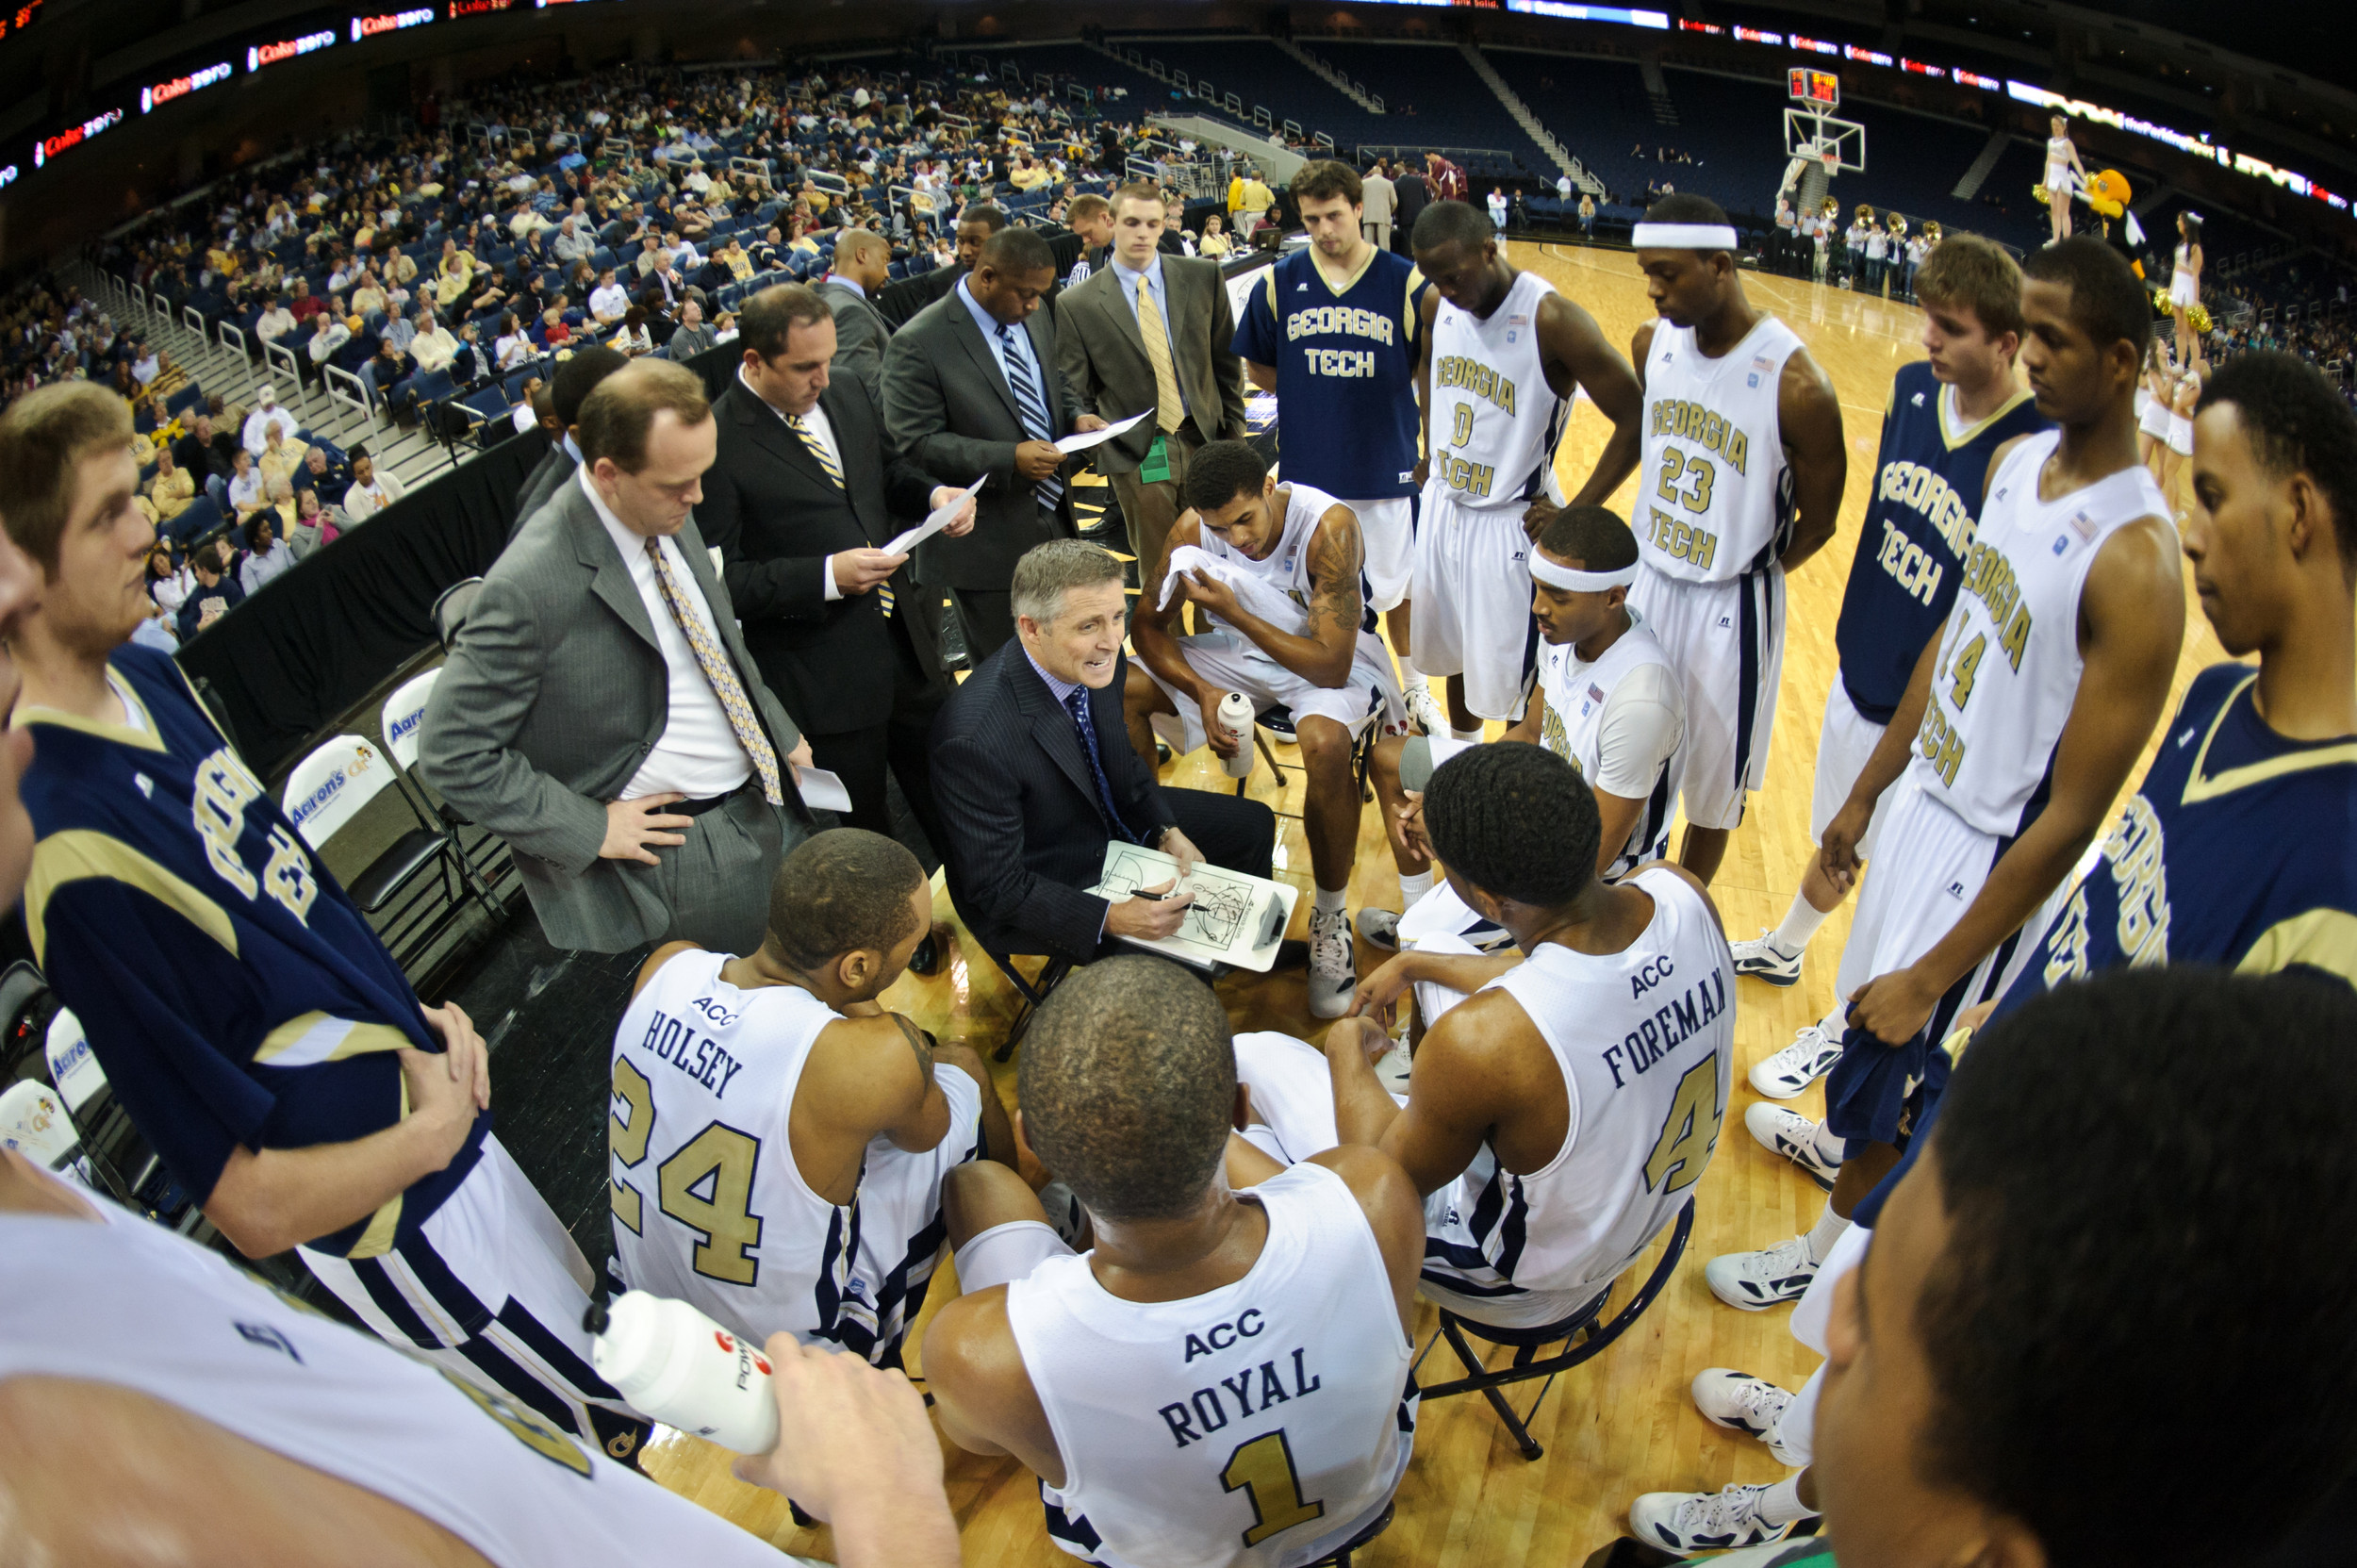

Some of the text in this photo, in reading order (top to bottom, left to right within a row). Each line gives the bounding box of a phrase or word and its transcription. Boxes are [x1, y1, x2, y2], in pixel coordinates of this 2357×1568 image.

[1286, 306, 1393, 347] GEORGIA
[1305, 347, 1376, 377] TECH
[1436, 355, 1516, 418] GEORGIA
[1451, 402, 1474, 449] 0
[1651, 399, 1748, 477] GEORGIA
[1437, 448, 1494, 497] TCH
[1656, 445, 1716, 514] 23
[1647, 504, 1717, 570] TECH
[1877, 519, 1942, 606] TECH
[1961, 541, 2032, 675] EORGIA
[1939, 608, 1986, 713] 14
[290, 769, 346, 830] Aaron's
[691, 992, 739, 1028] ACC
[1632, 954, 1674, 1000] ACC
[642, 1009, 743, 1100] HOLSEY
[1602, 966, 1726, 1090] FOREMAN
[1642, 1049, 1723, 1196] 4
[608, 1053, 764, 1288] 24
[1184, 1308, 1265, 1363] ACC
[1158, 1346, 1321, 1448] ROYAL
[1219, 1427, 1325, 1549] 1
